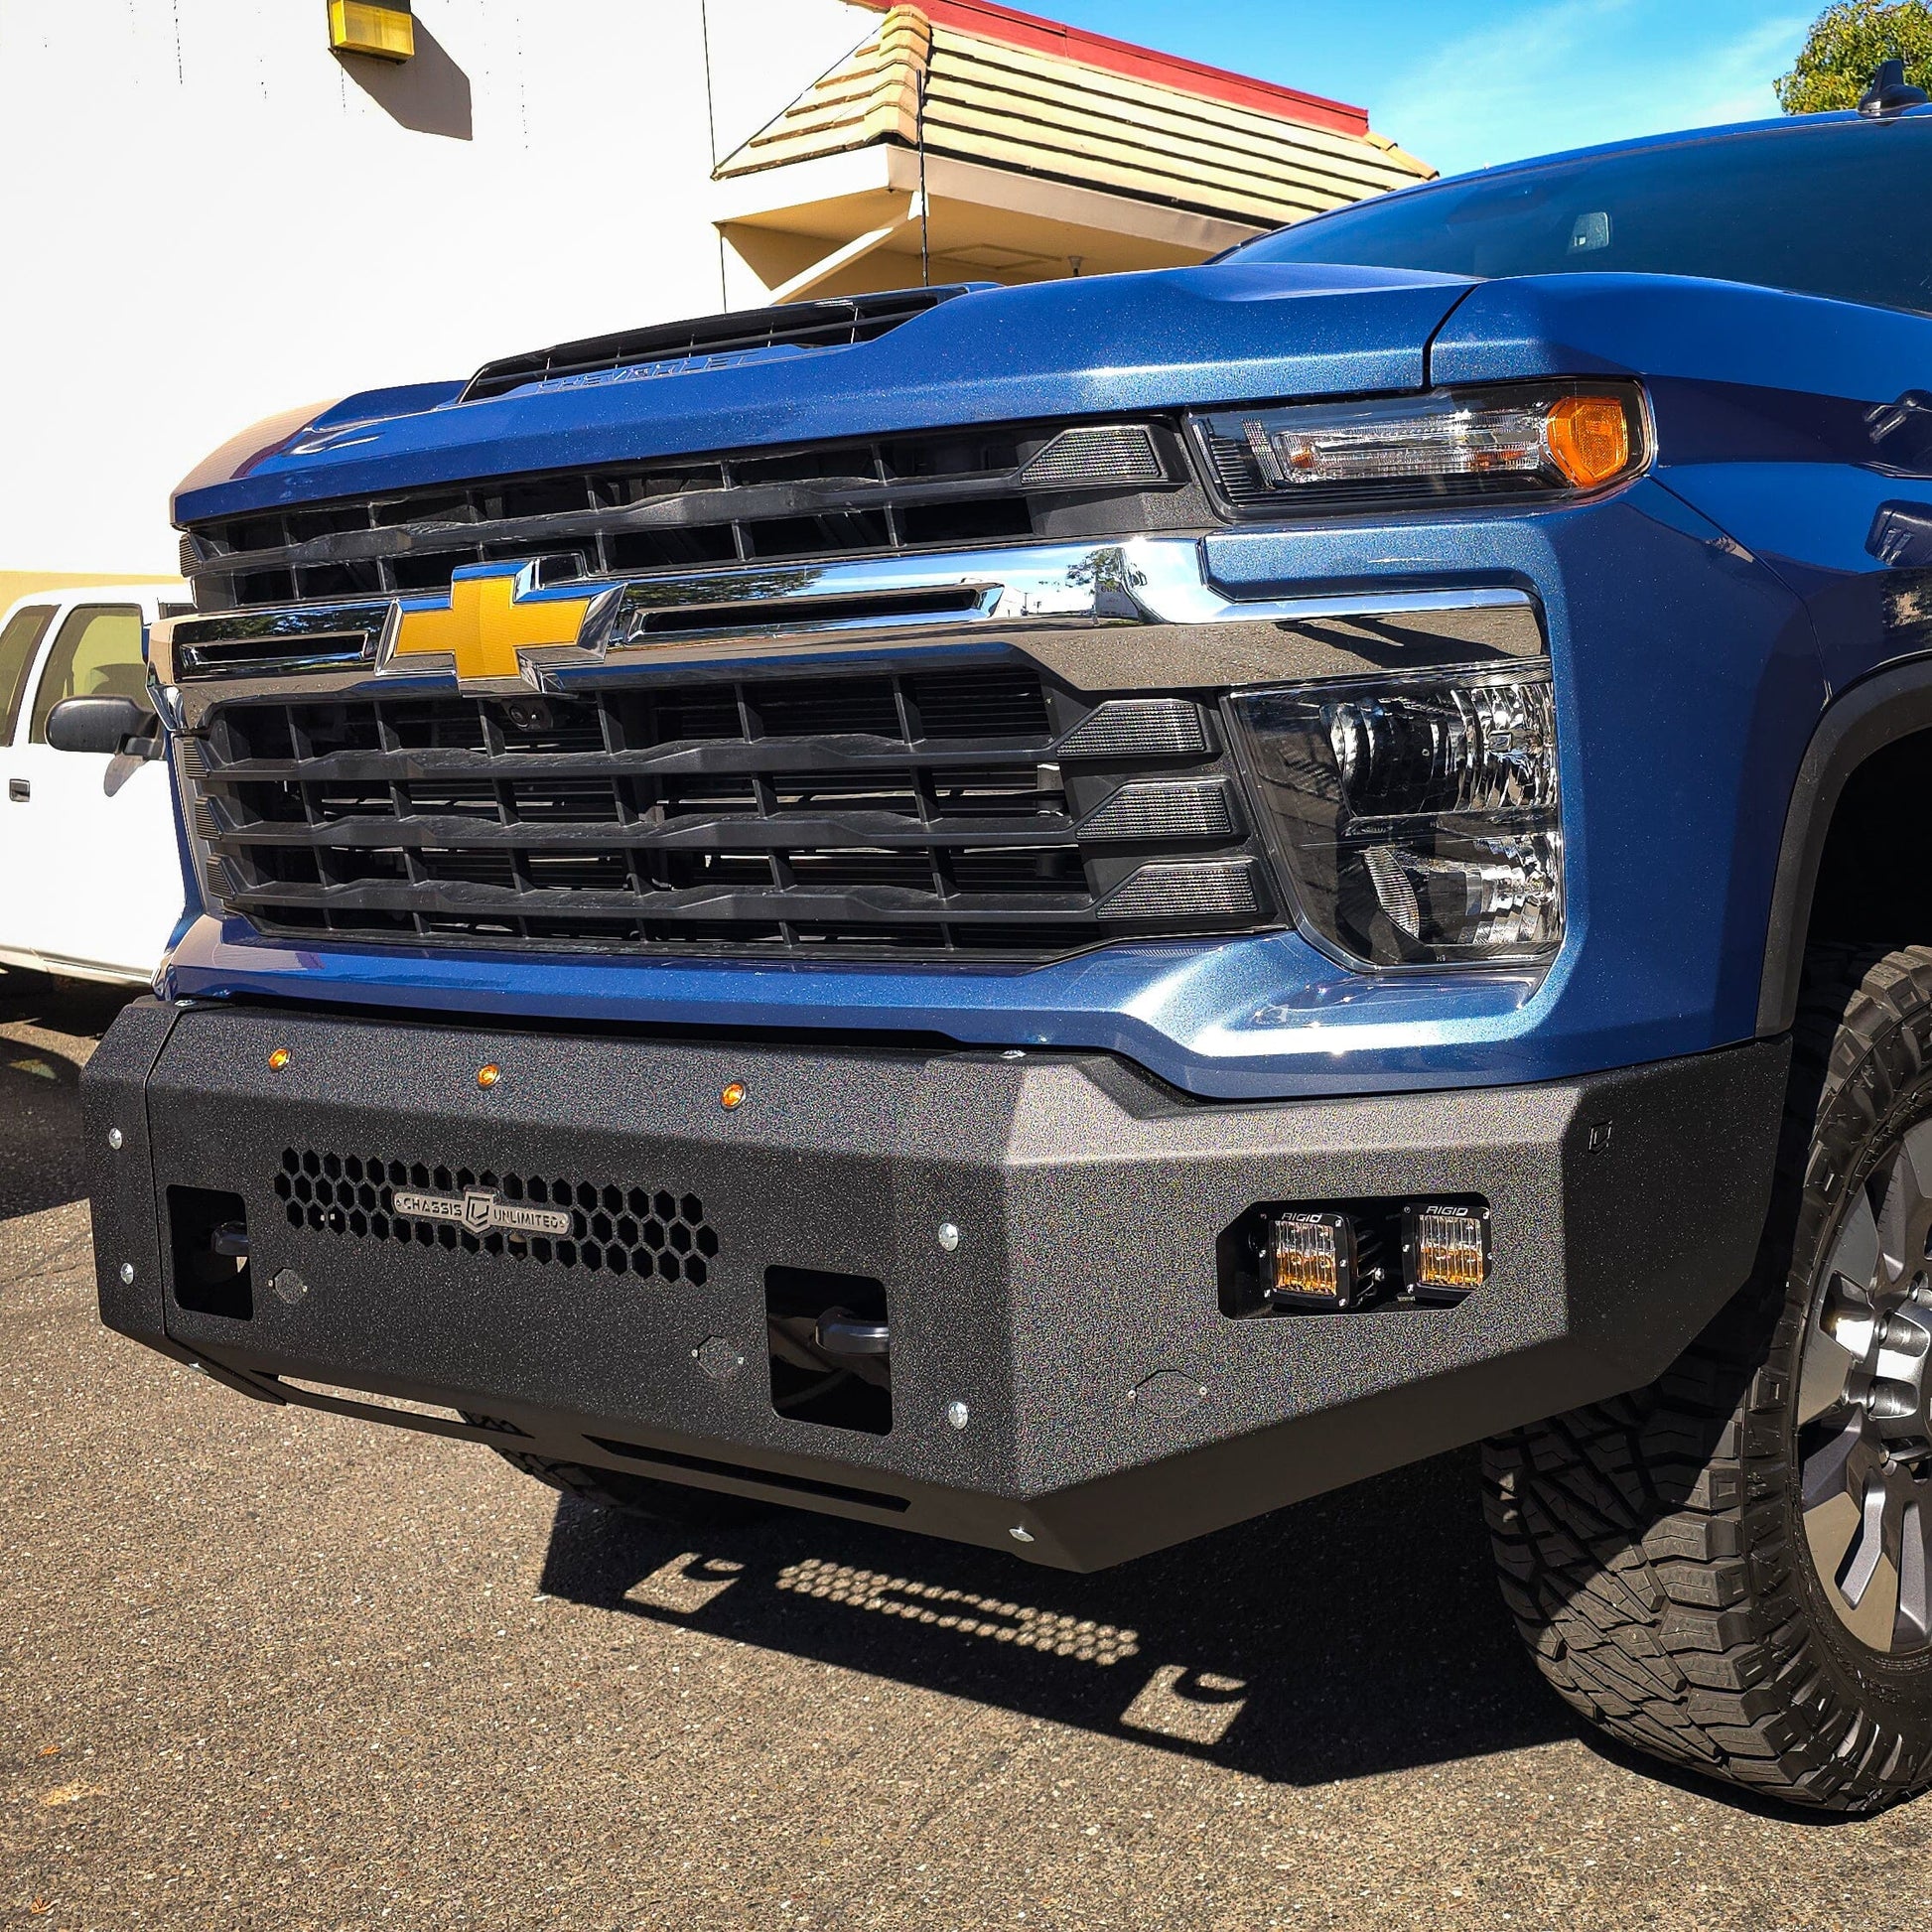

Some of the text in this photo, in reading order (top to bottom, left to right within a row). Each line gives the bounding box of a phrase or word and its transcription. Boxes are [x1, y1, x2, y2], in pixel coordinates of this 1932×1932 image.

[534, 350, 760, 394] CHEVROLET
[402, 1197, 560, 1229] CHASSIS UNLIMITED
[1281, 1212, 1323, 1223] RIGID
[1426, 1205, 1469, 1216] RIGID
